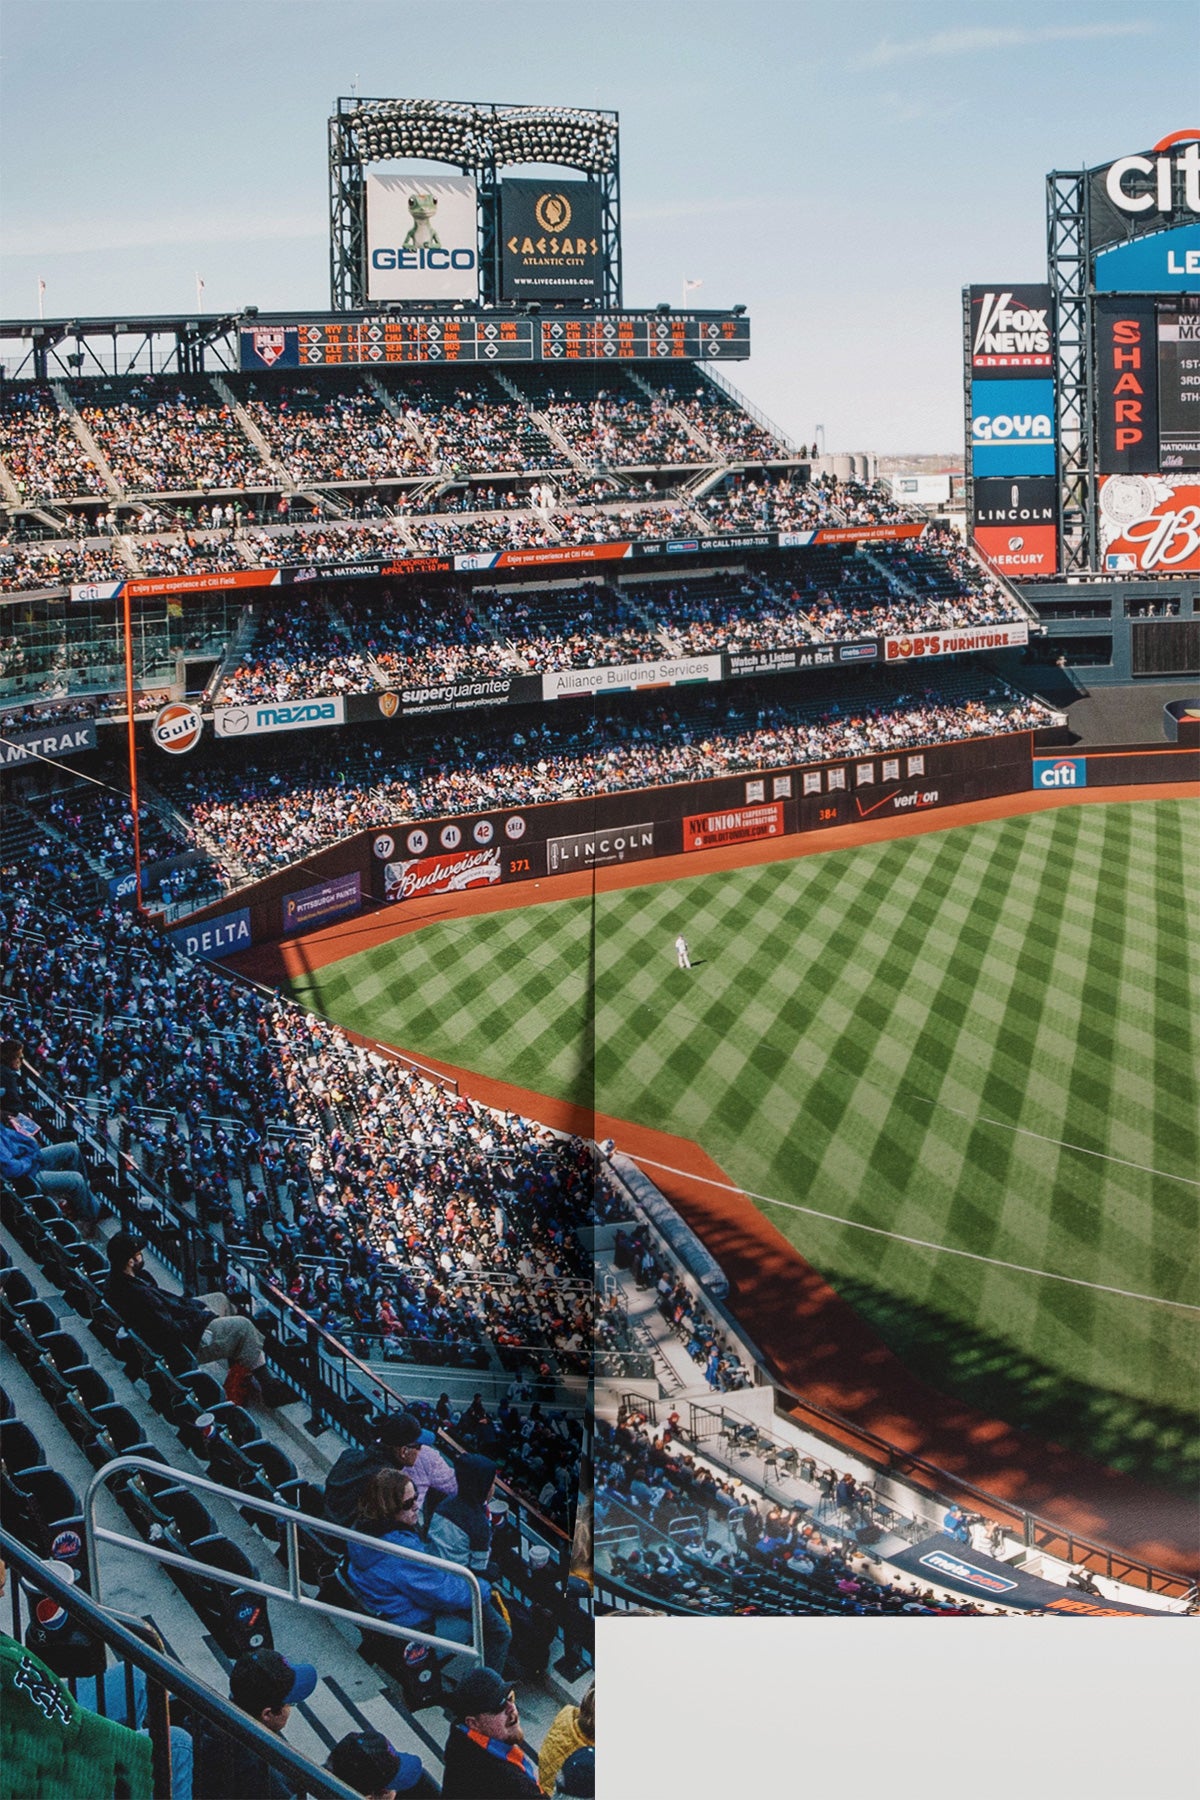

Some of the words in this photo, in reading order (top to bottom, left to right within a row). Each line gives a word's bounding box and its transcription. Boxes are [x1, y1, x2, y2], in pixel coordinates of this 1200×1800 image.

[507, 236, 599, 256] CAESARS
[372, 248, 475, 270] GEICO
[522, 257, 563, 266] ATLANTIC
[564, 257, 585, 266] CITY
[1167, 250, 1200, 274] LE
[363, 316, 425, 324] AMERICAN
[431, 315, 476, 323] LEAGUE
[997, 309, 1049, 332] FOX
[983, 332, 1050, 354] NEWS
[975, 355, 1051, 366] channel
[1112, 320, 1144, 451] SHARP
[972, 415, 1051, 440] GOYA
[978, 508, 1053, 521] LINCOLN
[643, 545, 660, 553] VISIT
[701, 541, 712, 549] OR
[713, 540, 730, 548] CALL
[392, 558, 439, 567] TOMORROW
[460, 558, 479, 570] citi
[507, 555, 522, 564] Enjoy
[522, 554, 535, 562] your
[535, 552, 564, 562] experience
[987, 553, 1044, 565] MERCURY
[334, 565, 379, 576] NATIONALS
[381, 566, 404, 576] APRIL
[406, 565, 414, 573] 11
[421, 564, 436, 573] 1:10
[437, 563, 450, 571] PM
[133, 585, 150, 594] Enjoy
[151, 584, 165, 593] your
[166, 582, 199, 591] experience
[207, 579, 218, 587] Citi
[219, 577, 237, 586] Field.
[79, 588, 99, 600] citi
[887, 636, 940, 659] BOB'S
[943, 633, 1009, 652] FURNITURE
[730, 655, 759, 668] Watch
[760, 654, 768, 664] &
[769, 652, 796, 663] Listen
[800, 655, 813, 666] At
[814, 652, 834, 664] Bat
[556, 675, 603, 690] Alliance
[607, 669, 656, 684] Building
[659, 662, 709, 677] Services
[401, 680, 511, 704] superguarantee
[157, 716, 199, 741] Gulf
[0, 729, 90, 765] MTRAK
[1040, 765, 1076, 787] citi
[894, 788, 938, 808] verizon
[819, 808, 837, 821] 384
[476, 825, 490, 838] 42
[507, 822, 523, 833] SHEA
[412, 835, 423, 847] 14
[445, 831, 456, 842] 41
[377, 841, 391, 853] 37
[560, 833, 653, 860] LINCOLN
[510, 859, 530, 873] 371
[391, 848, 500, 900] Budweiser
[186, 920, 249, 956] DELTA
[928, 1556, 1007, 1590] mets.com
